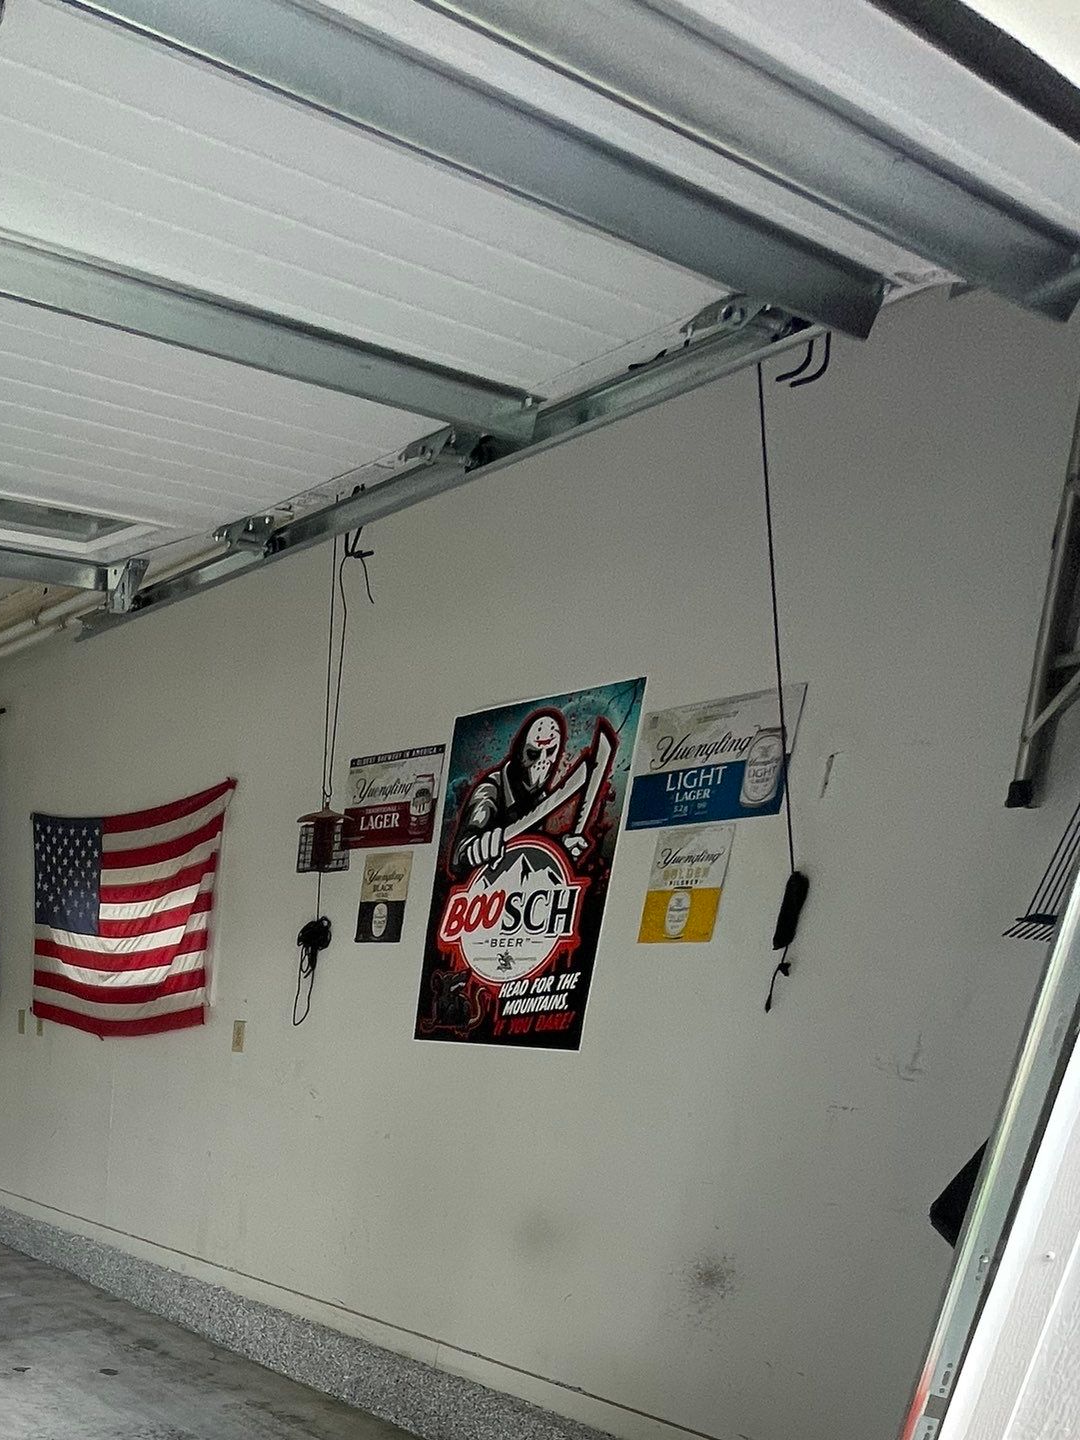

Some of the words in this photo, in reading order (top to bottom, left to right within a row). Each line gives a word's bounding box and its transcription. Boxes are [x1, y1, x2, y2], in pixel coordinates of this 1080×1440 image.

[356, 757, 376, 766] OLDEST
[377, 753, 402, 763] BREWERY
[411, 747, 437, 757] AMERICA
[649, 730, 756, 770] Yuengling
[352, 777, 416, 805] Yuengling
[665, 765, 728, 792] LIGHT
[674, 788, 711, 803] LAGER
[359, 812, 400, 831] LAGER
[657, 846, 725, 869] Yuengling
[443, 887, 580, 938] BOOSCH
[498, 979, 529, 998] HEAD
[531, 975, 555, 995] FOR
[556, 972, 581, 991] THE
[502, 993, 569, 1016] MOUNTAINS.
[493, 1018, 505, 1036] IF
[508, 1015, 533, 1035] YOU
[535, 1010, 576, 1032] DARE!
